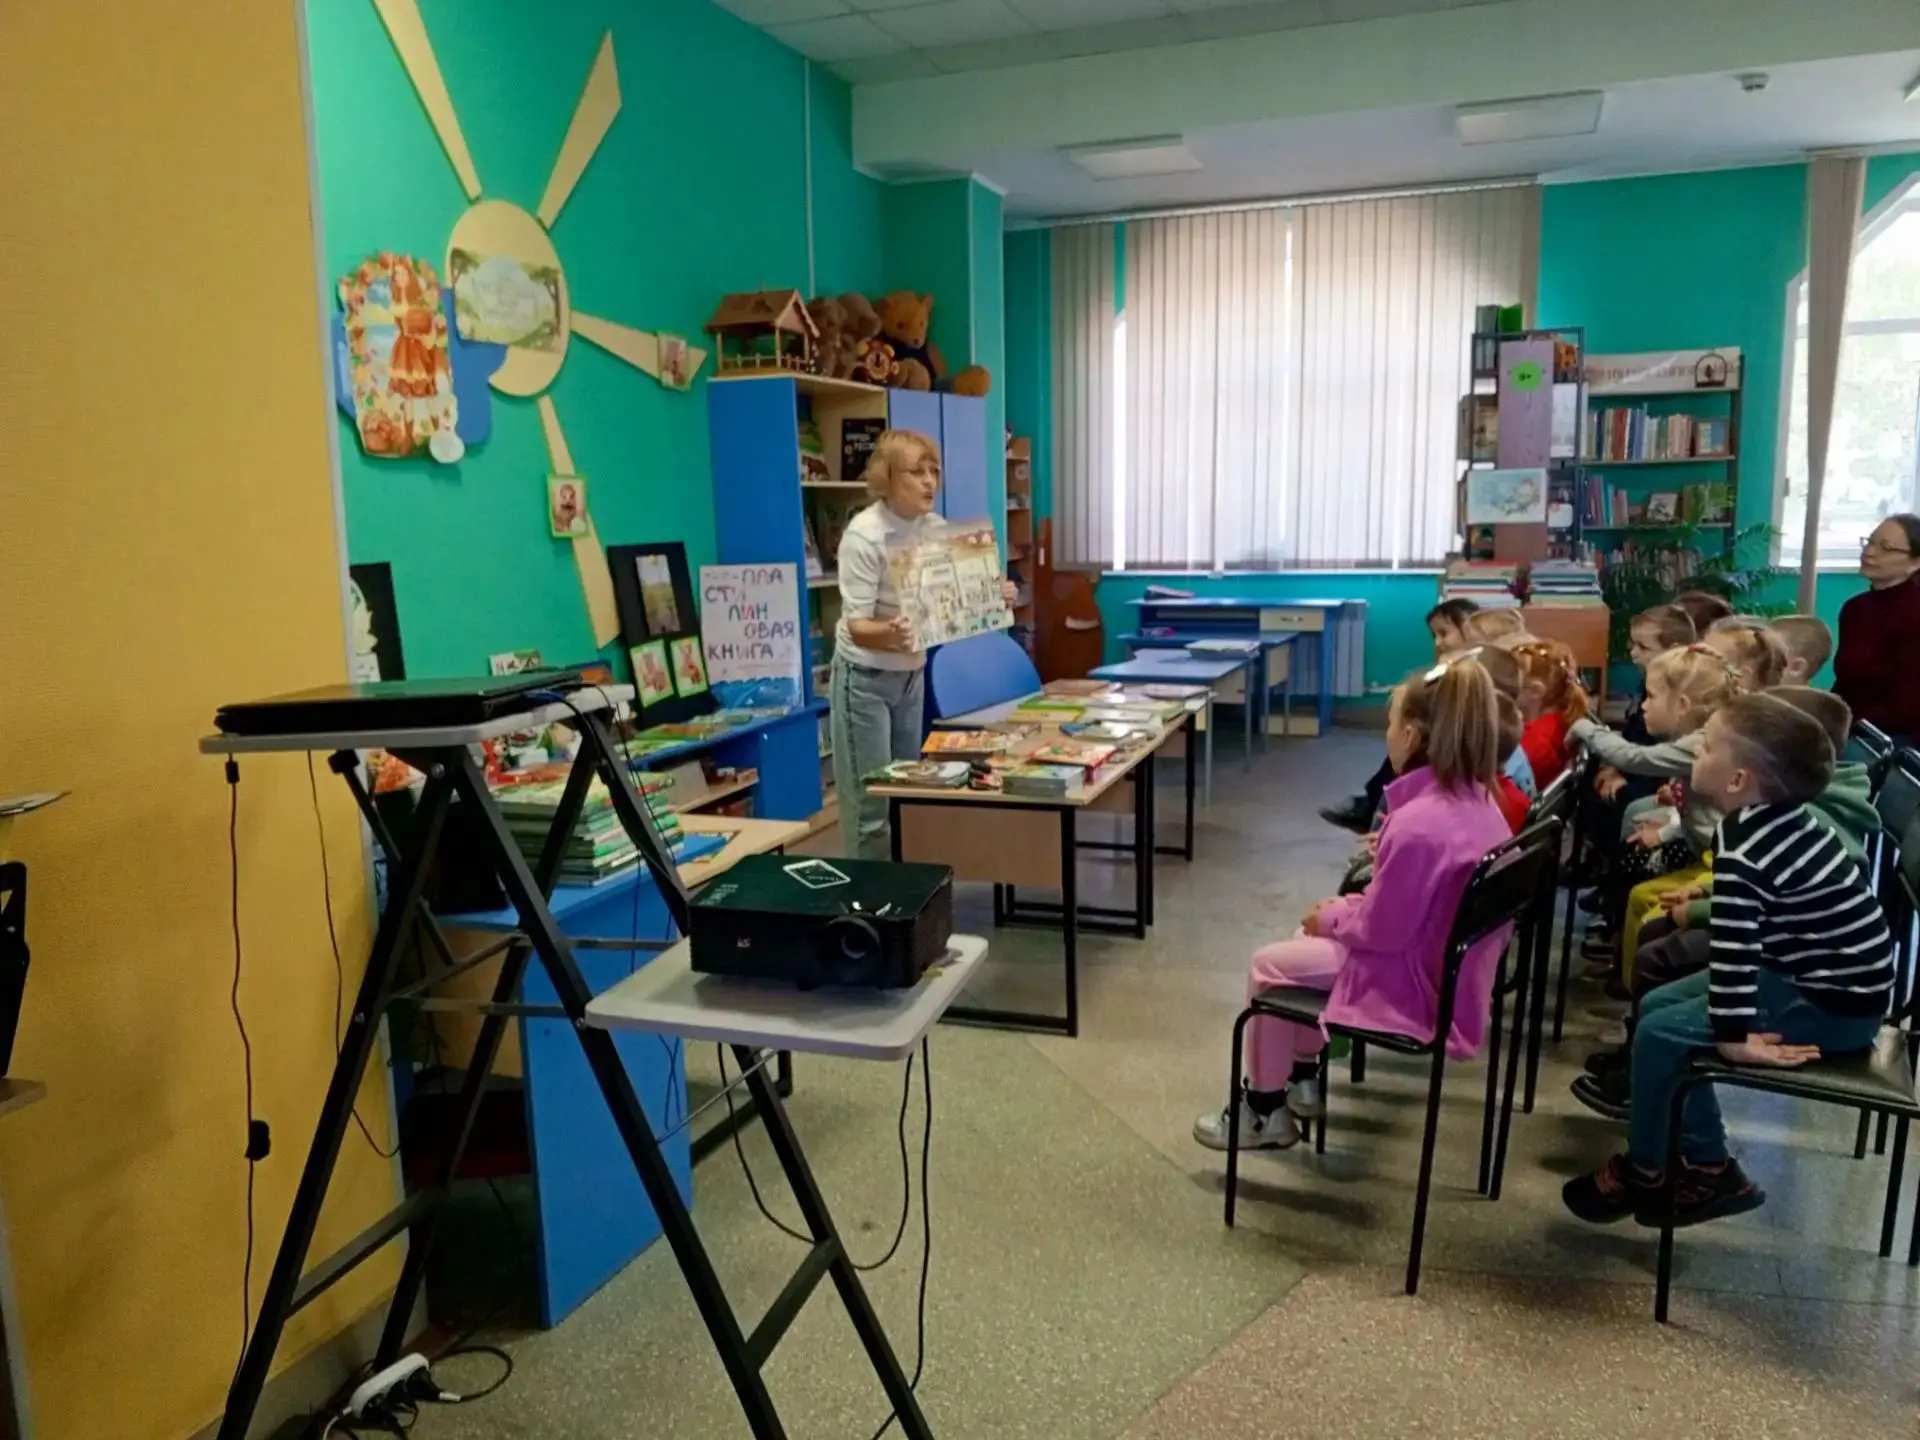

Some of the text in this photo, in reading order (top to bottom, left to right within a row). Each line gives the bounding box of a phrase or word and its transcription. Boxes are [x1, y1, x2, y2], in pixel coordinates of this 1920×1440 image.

[742, 567, 784, 585] ПЛА
[728, 602, 768, 622] ЛИН
[744, 620, 795, 639] ОВАЯ
[708, 643, 774, 661] КНИГА
